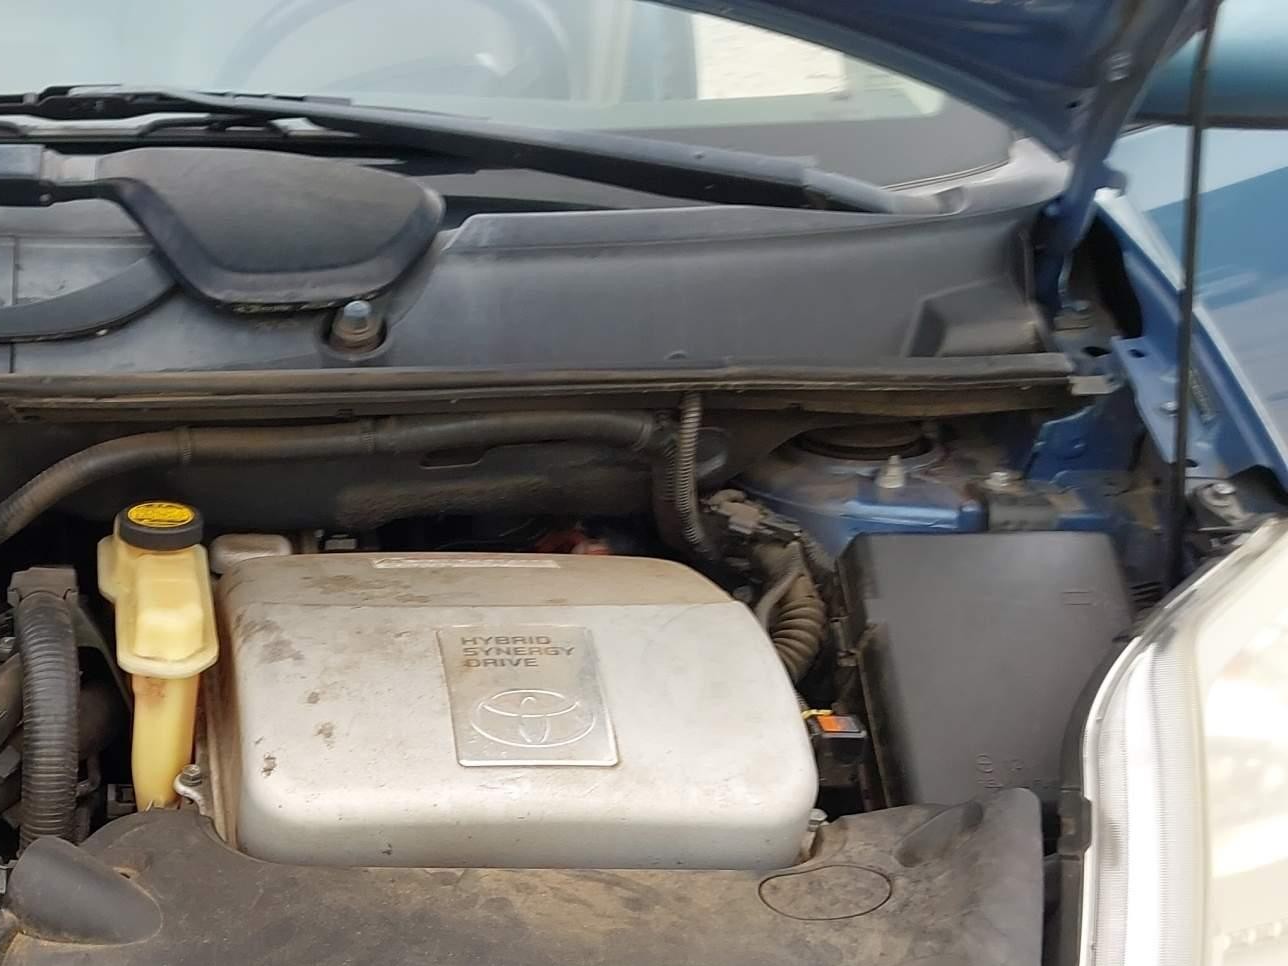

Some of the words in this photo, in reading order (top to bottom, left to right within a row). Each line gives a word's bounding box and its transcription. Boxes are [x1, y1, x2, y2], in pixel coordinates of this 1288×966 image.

[461, 636, 551, 646] HYBRID
[462, 646, 575, 657] SYNERGY
[464, 657, 539, 668] DRIVE
